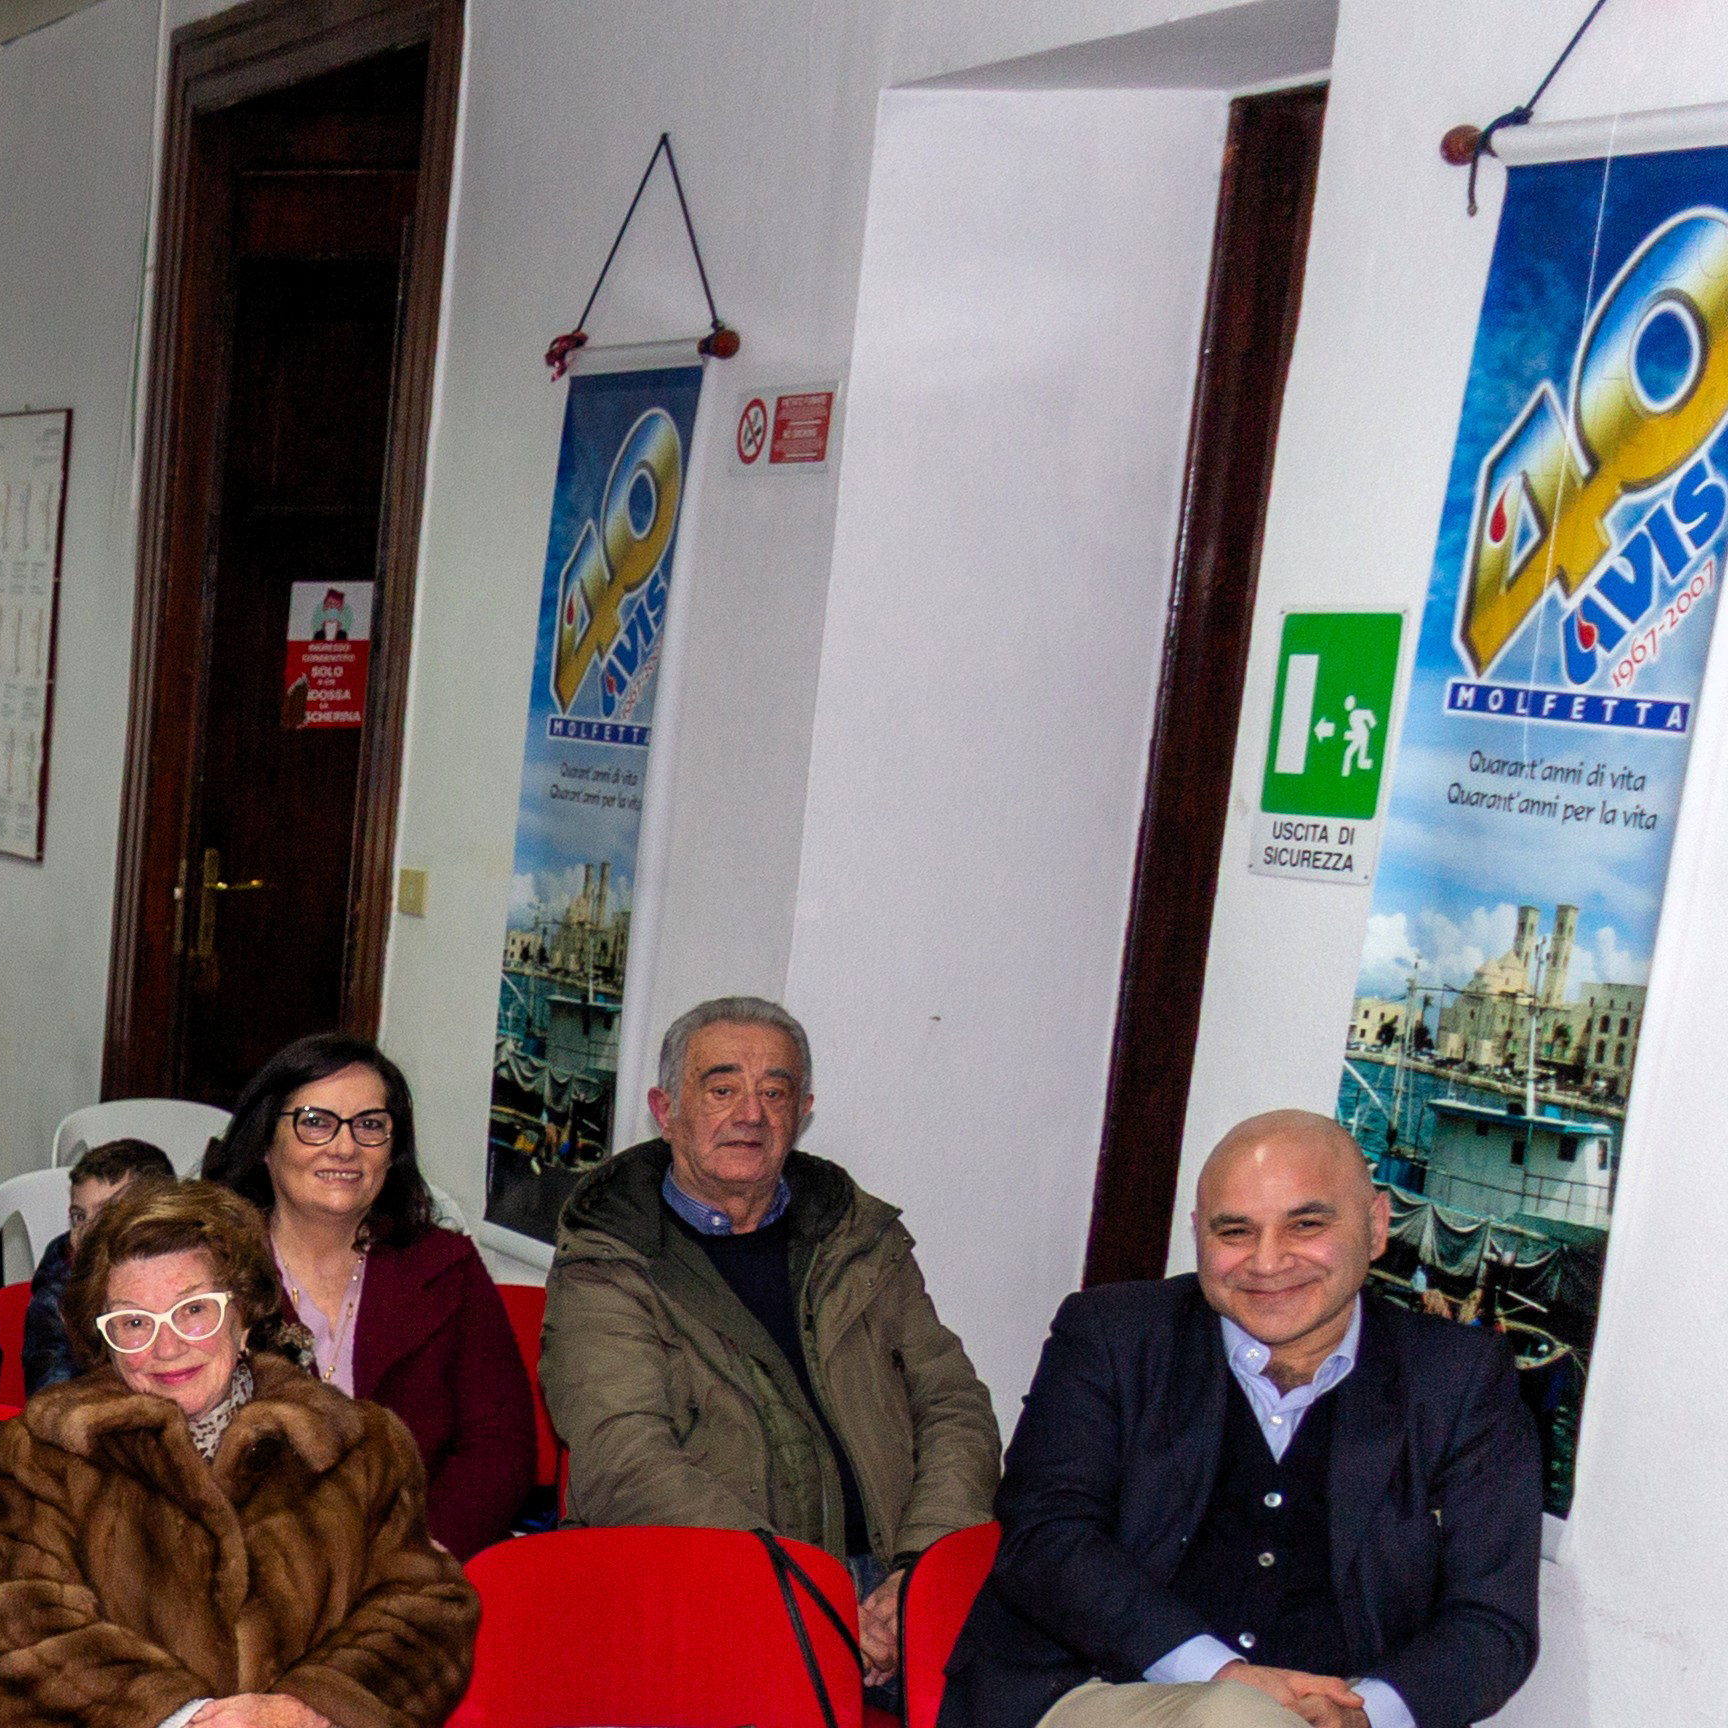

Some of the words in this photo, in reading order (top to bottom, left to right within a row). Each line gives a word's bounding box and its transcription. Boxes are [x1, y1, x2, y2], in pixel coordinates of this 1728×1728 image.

[1560, 458, 1727, 686] AVIS
[1611, 560, 1715, 688] 1967-2007
[311, 665, 344, 678] SOLO
[1456, 685, 1684, 730] MOLFETTA
[612, 767, 620, 784] di
[622, 769, 638, 786] vita
[1469, 750, 1583, 786] Quarant'anni
[1587, 764, 1604, 787] di
[1610, 767, 1646, 792] vita
[1447, 782, 1558, 818] Quarant'anni
[1562, 804, 1593, 825] per
[1600, 802, 1617, 826] la
[1622, 805, 1657, 831] vita
[1273, 821, 1328, 843] USCITA
[1339, 826, 1355, 845] DI
[1264, 846, 1354, 872] SICUREZZA
